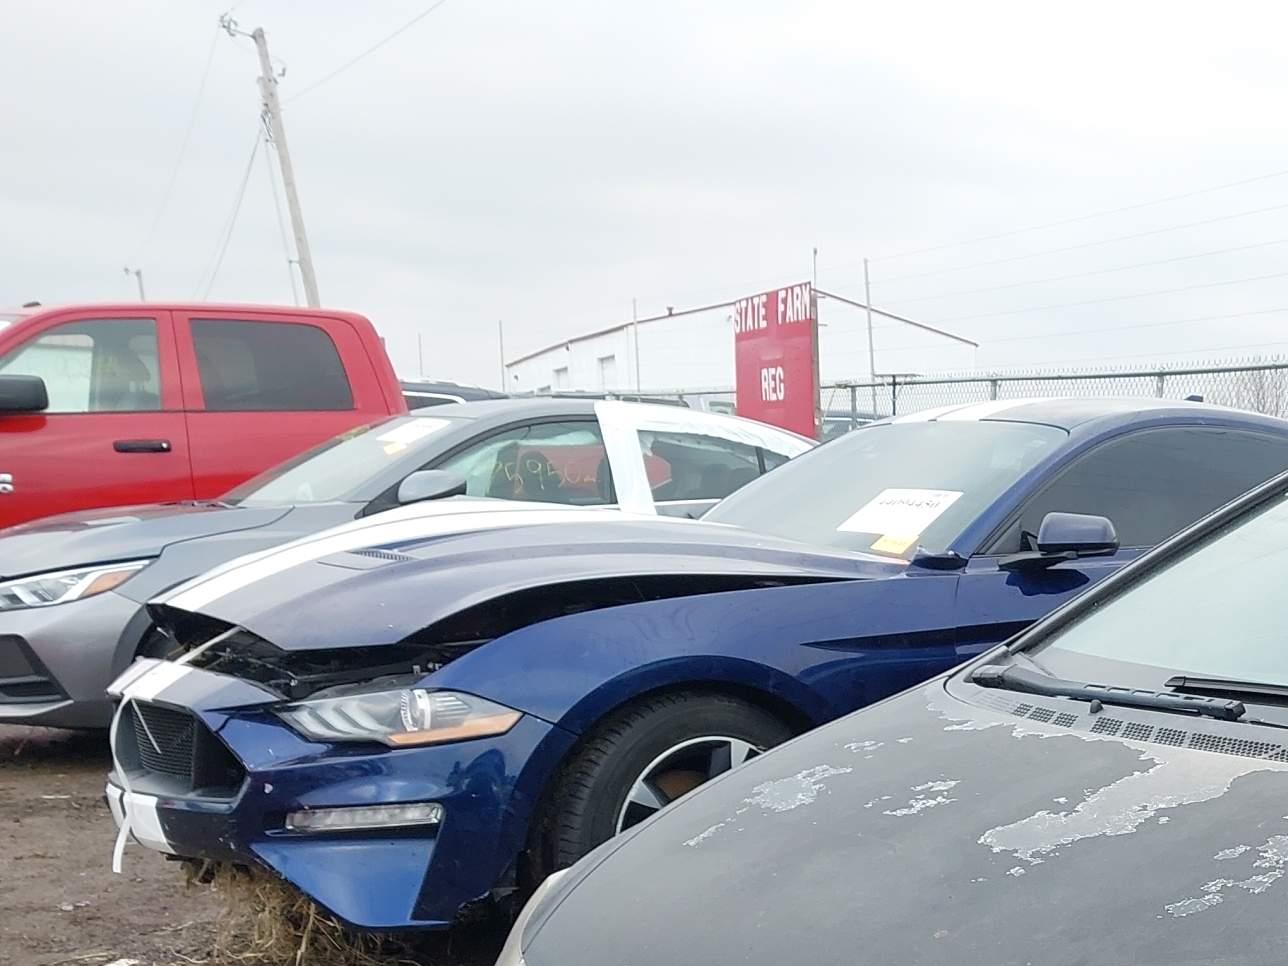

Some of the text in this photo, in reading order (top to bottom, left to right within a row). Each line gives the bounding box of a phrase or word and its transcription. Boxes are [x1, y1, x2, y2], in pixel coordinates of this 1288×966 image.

[734, 283, 811, 334] STATE FARM
[761, 366, 785, 401] REG
